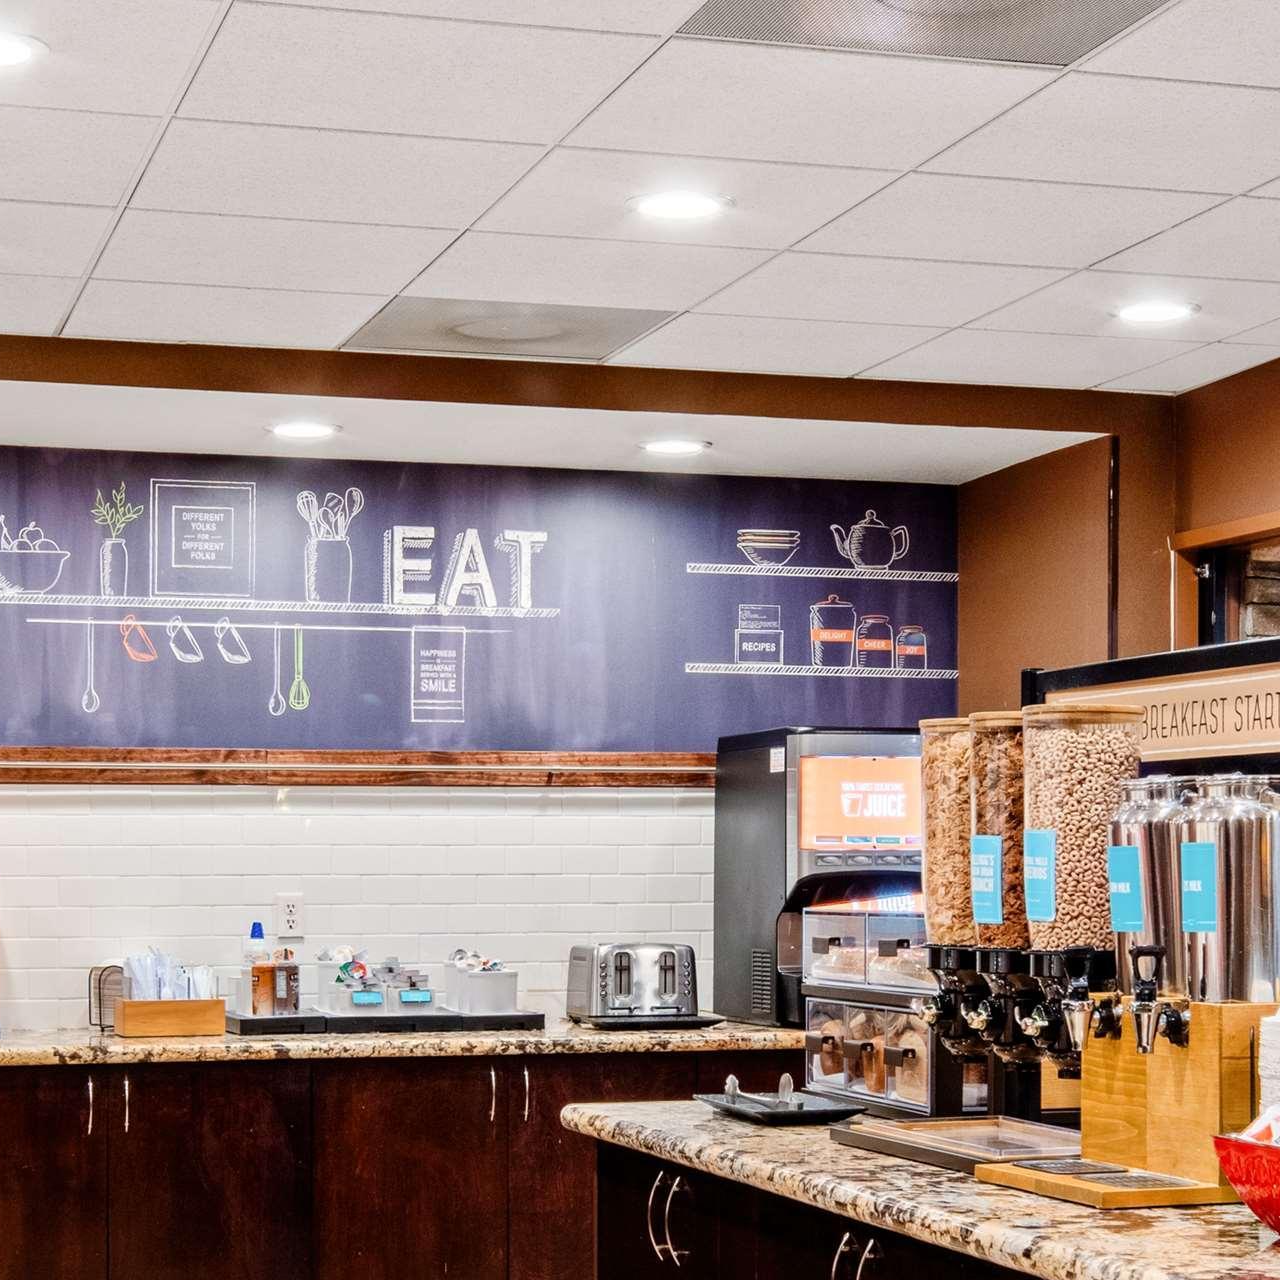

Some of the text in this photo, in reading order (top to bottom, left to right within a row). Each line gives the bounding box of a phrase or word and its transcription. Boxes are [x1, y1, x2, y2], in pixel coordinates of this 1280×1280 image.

[182, 512, 225, 522] DIFFERENT
[191, 522, 217, 531] YOLKS
[182, 541, 225, 552] DIFFERENT
[190, 551, 216, 561] FOLKS
[384, 525, 548, 615] EAT
[819, 631, 848, 639] DELIGHT
[742, 641, 777, 652] RECIPES
[863, 641, 886, 649] CHEER
[905, 646, 918, 654] JOY
[420, 649, 457, 658] HAPPINESS
[420, 663, 457, 672] BREAKFAST
[420, 678, 457, 692] SMILE
[1142, 697, 1227, 740] BREAKFAST
[863, 793, 907, 817] JUICE
